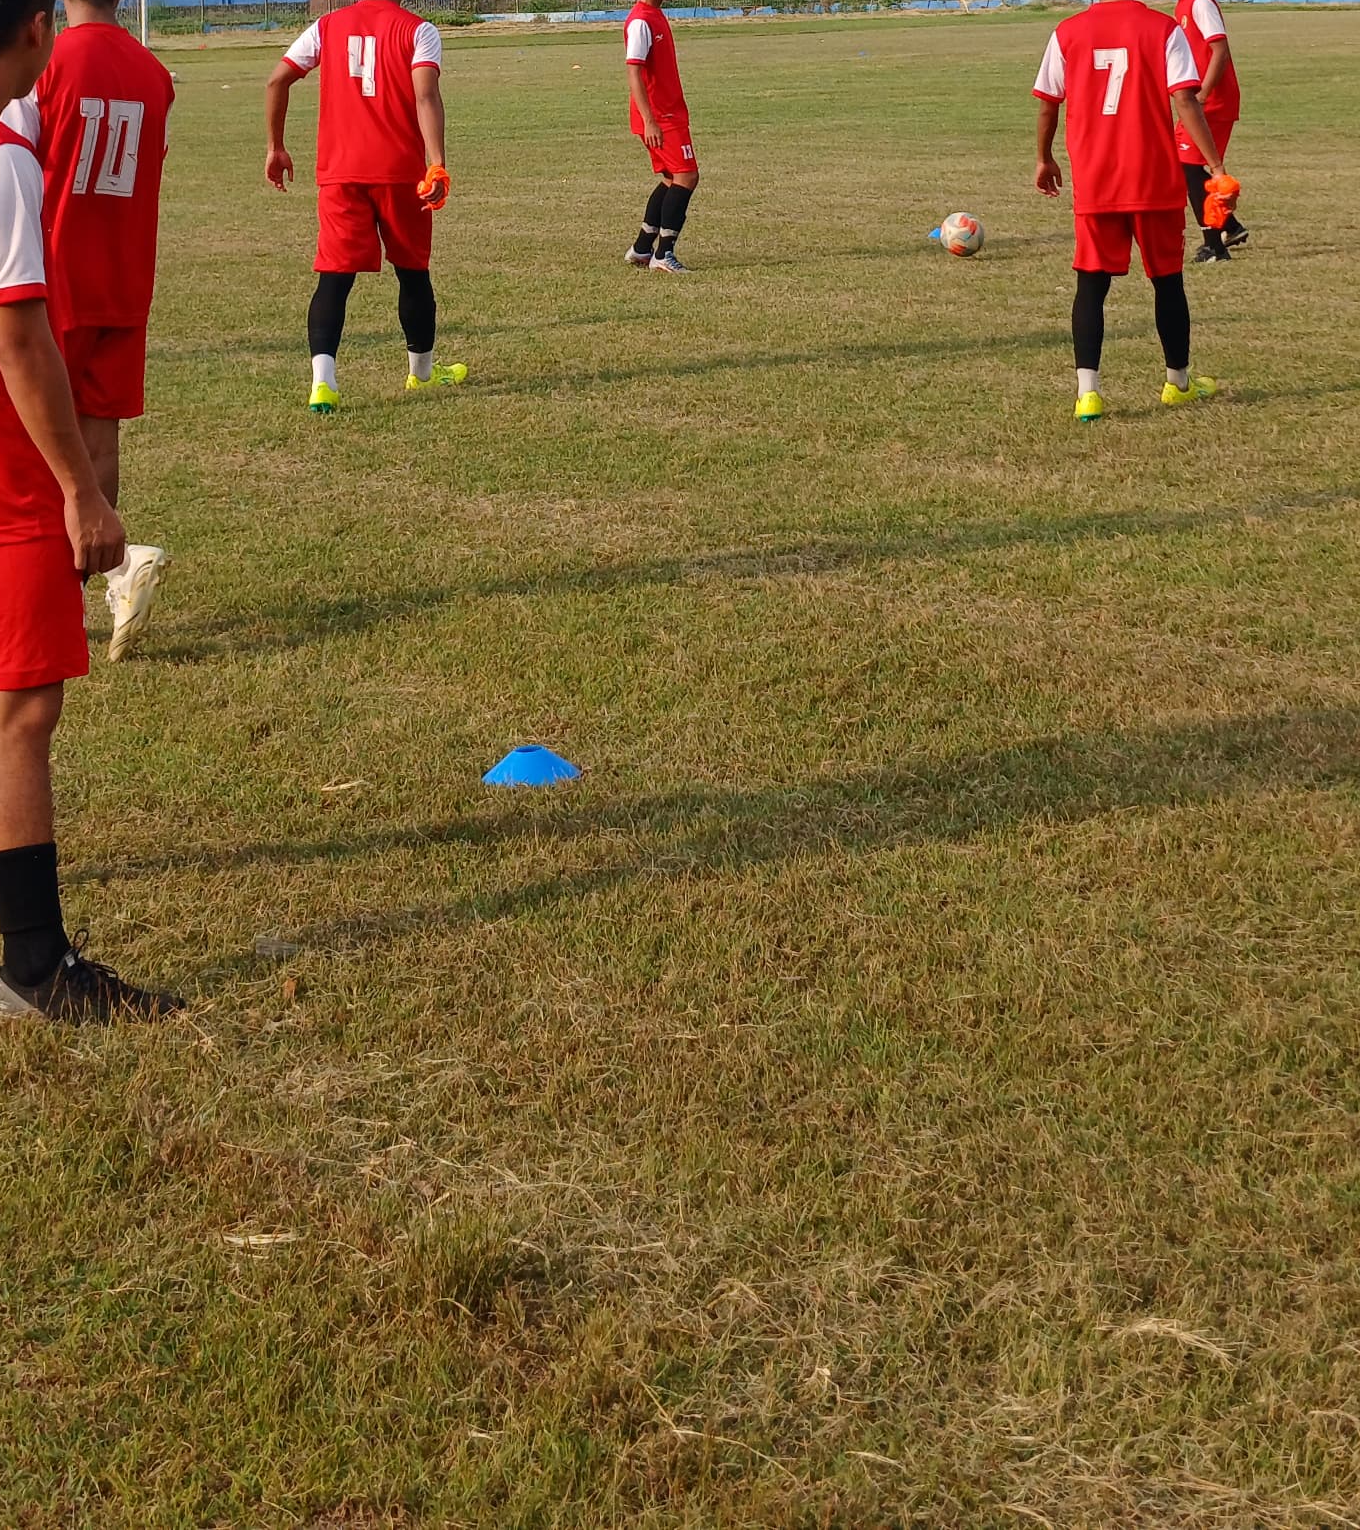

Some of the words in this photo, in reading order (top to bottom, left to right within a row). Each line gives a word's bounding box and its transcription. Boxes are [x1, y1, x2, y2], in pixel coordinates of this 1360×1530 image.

[347, 35, 376, 97] 4
[1093, 47, 1128, 115] 7
[72, 97, 144, 197] 10
